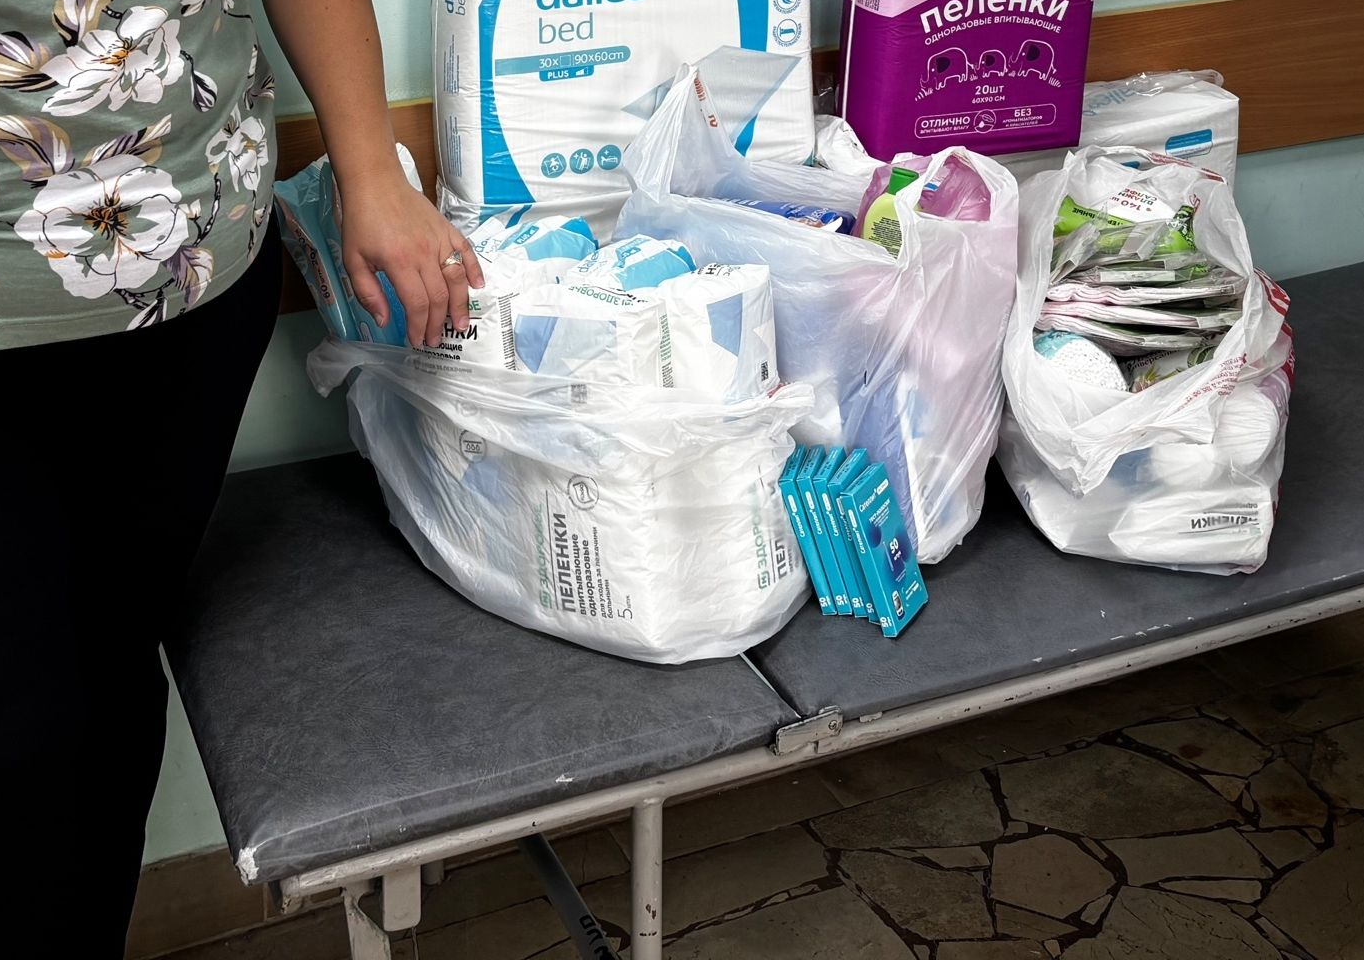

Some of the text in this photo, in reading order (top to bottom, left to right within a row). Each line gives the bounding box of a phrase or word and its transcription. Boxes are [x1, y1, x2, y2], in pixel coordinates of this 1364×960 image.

[539, 12, 593, 44] bed
[924, 15, 1062, 45] ОДНОРАЗОВЫЕ ВПИТЫВАЮЩИЕ
[547, 70, 569, 80] PLUS
[921, 116, 970, 128] ОТЛИЧНО
[1014, 108, 1031, 117] БЕЗ
[890, 537, 899, 554] 50
[553, 513, 576, 613] ПЕЛЕНКИ
[571, 534, 586, 615] впитывающие
[584, 540, 597, 617] одноразовые
[618, 608, 632, 619] 5
